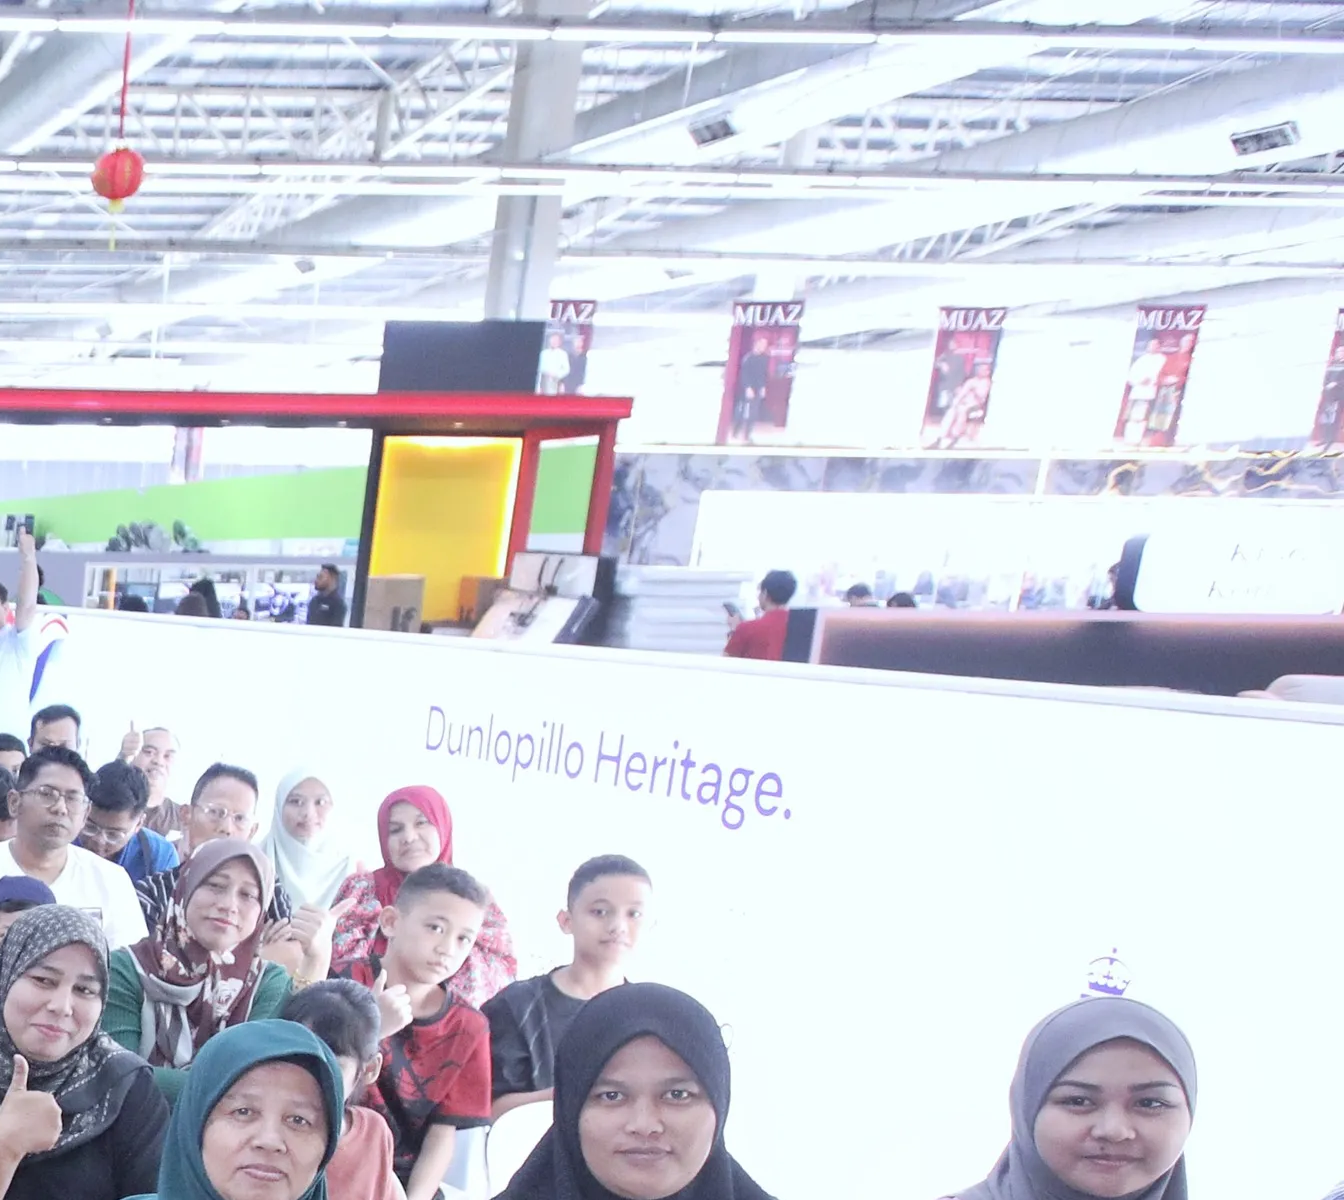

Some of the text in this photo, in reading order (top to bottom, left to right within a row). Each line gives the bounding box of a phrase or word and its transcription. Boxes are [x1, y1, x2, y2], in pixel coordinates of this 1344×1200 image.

[549, 302, 595, 324] UAZ
[733, 303, 802, 326] MUAZ
[939, 309, 1006, 331] MUAZ
[1137, 309, 1204, 331] MUAZ
[426, 705, 792, 830] Dunlopillo Heritage.
